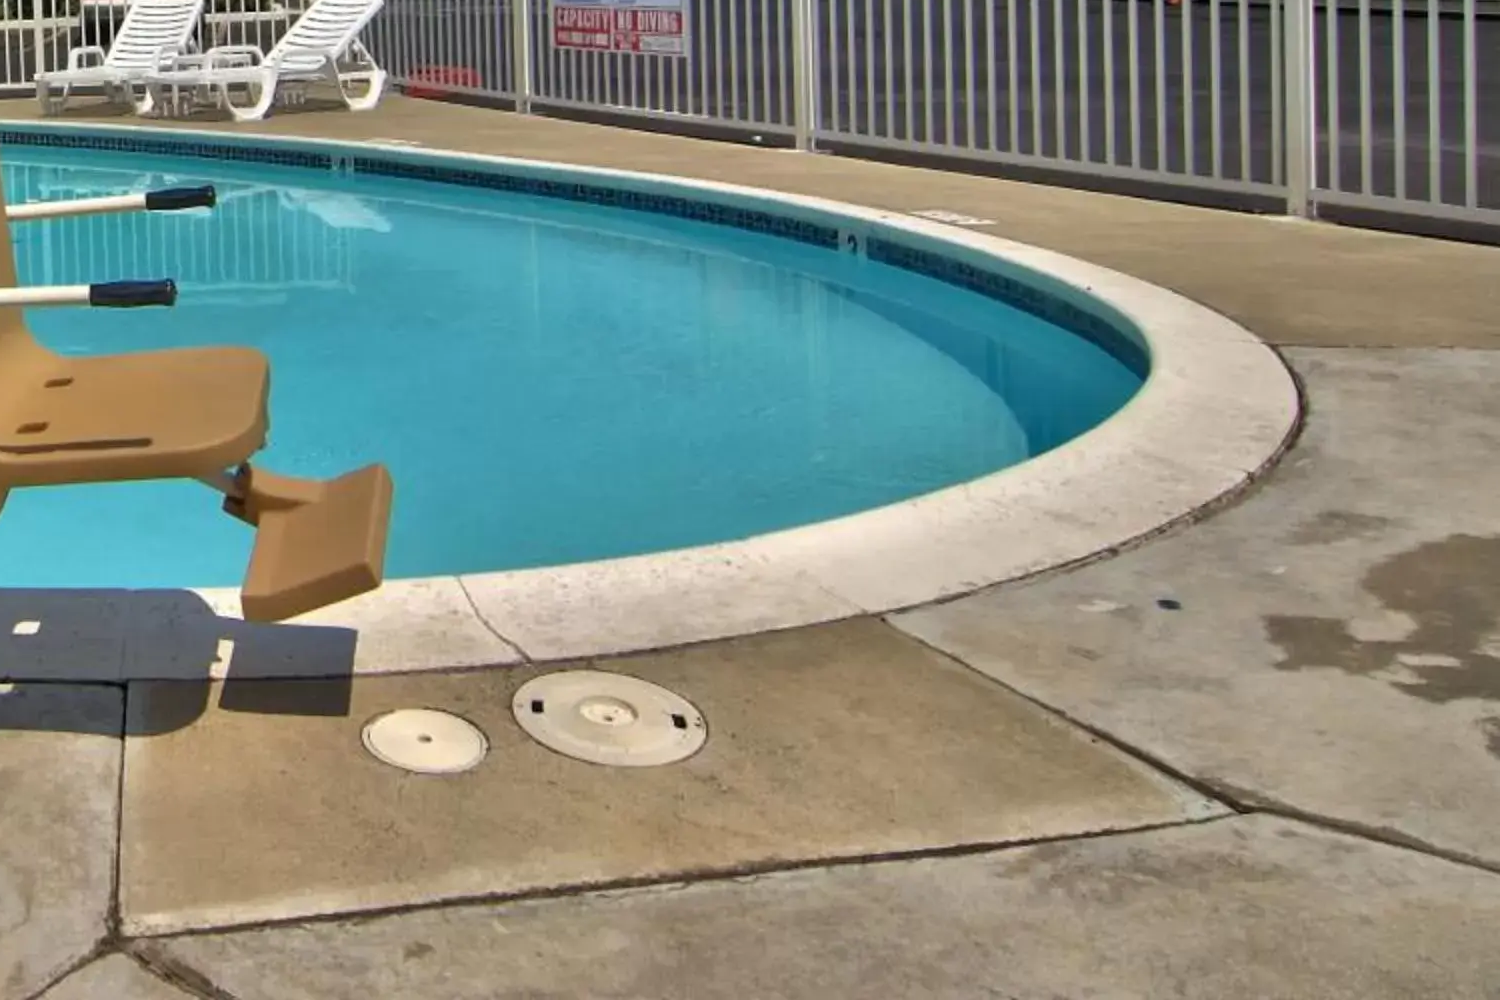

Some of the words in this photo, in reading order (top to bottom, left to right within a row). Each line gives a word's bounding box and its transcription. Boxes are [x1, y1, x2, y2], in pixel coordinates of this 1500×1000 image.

[555, 7, 610, 30] CAPACITY
[617, 10, 633, 31] NO
[637, 10, 679, 32] DIVING
